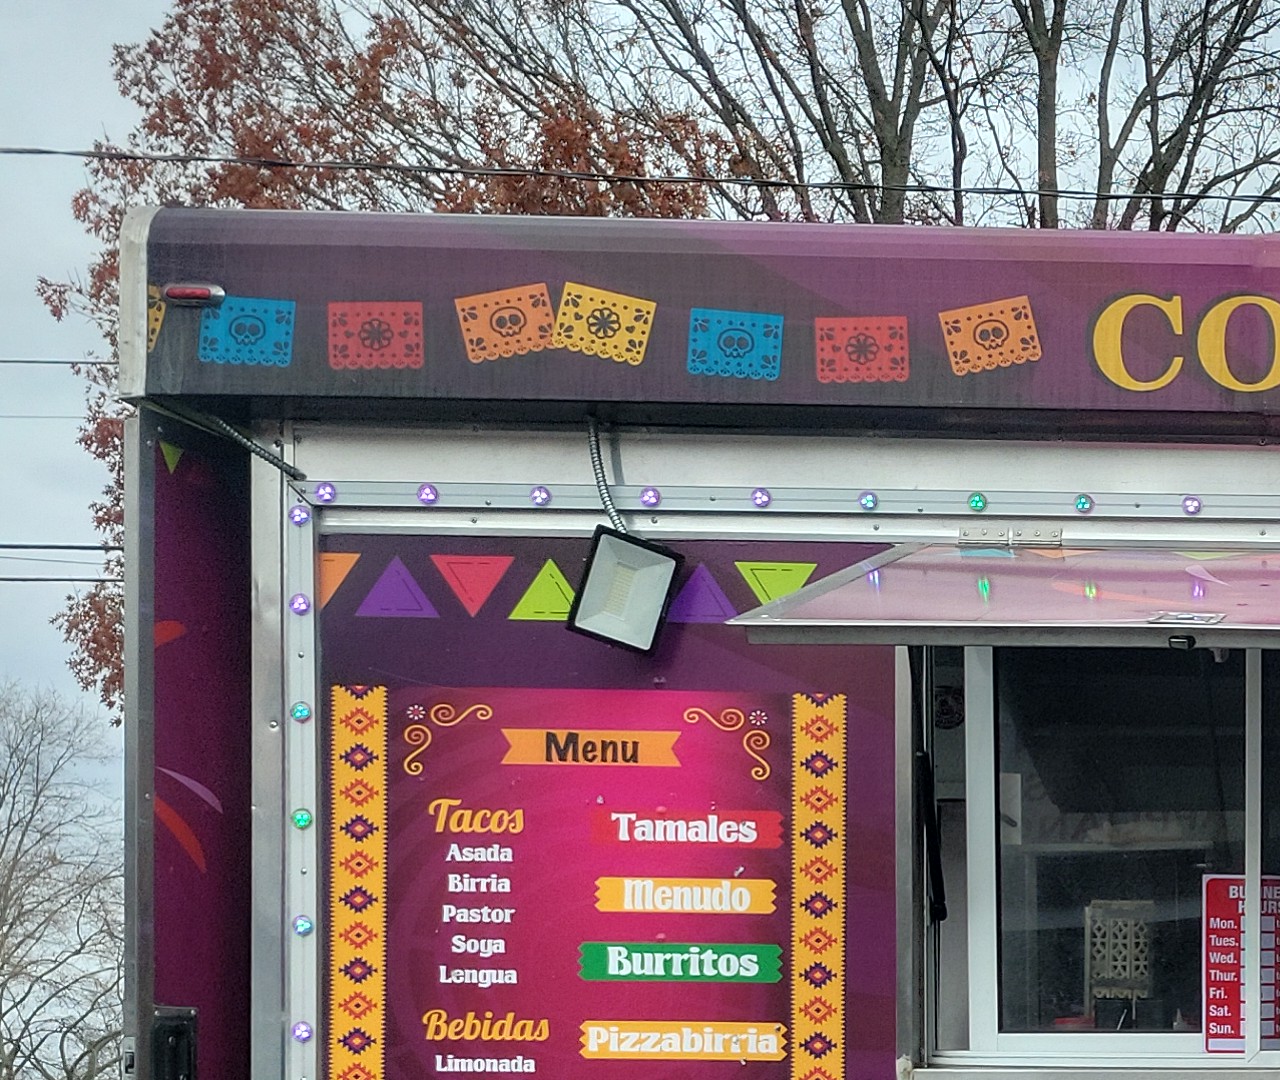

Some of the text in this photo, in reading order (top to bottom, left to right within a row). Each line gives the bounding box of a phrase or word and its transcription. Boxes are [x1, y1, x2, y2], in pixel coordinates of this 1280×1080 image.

[544, 731, 640, 764] Menu
[429, 798, 527, 835] Tacos
[610, 813, 758, 843] Tamales
[446, 843, 514, 863] Asada
[447, 874, 511, 894] Birria
[622, 879, 751, 912] Menudo
[442, 904, 515, 924] Pastor
[1208, 918, 1238, 929] Mon.
[451, 935, 506, 956] Soya
[1208, 935, 1239, 947] Tues.
[607, 946, 759, 977] Burritos
[1208, 952, 1238, 964] Wed.
[439, 965, 518, 988] Lengua
[1208, 970, 1238, 982] Thur.
[1208, 988, 1228, 999] Fri.
[1208, 1005, 1232, 1017] Sat.
[422, 1009, 550, 1042] Bebidas
[1208, 1023, 1235, 1034] Sun.
[587, 1026, 780, 1054] Pizzabirria
[435, 1054, 536, 1073] Limonada
